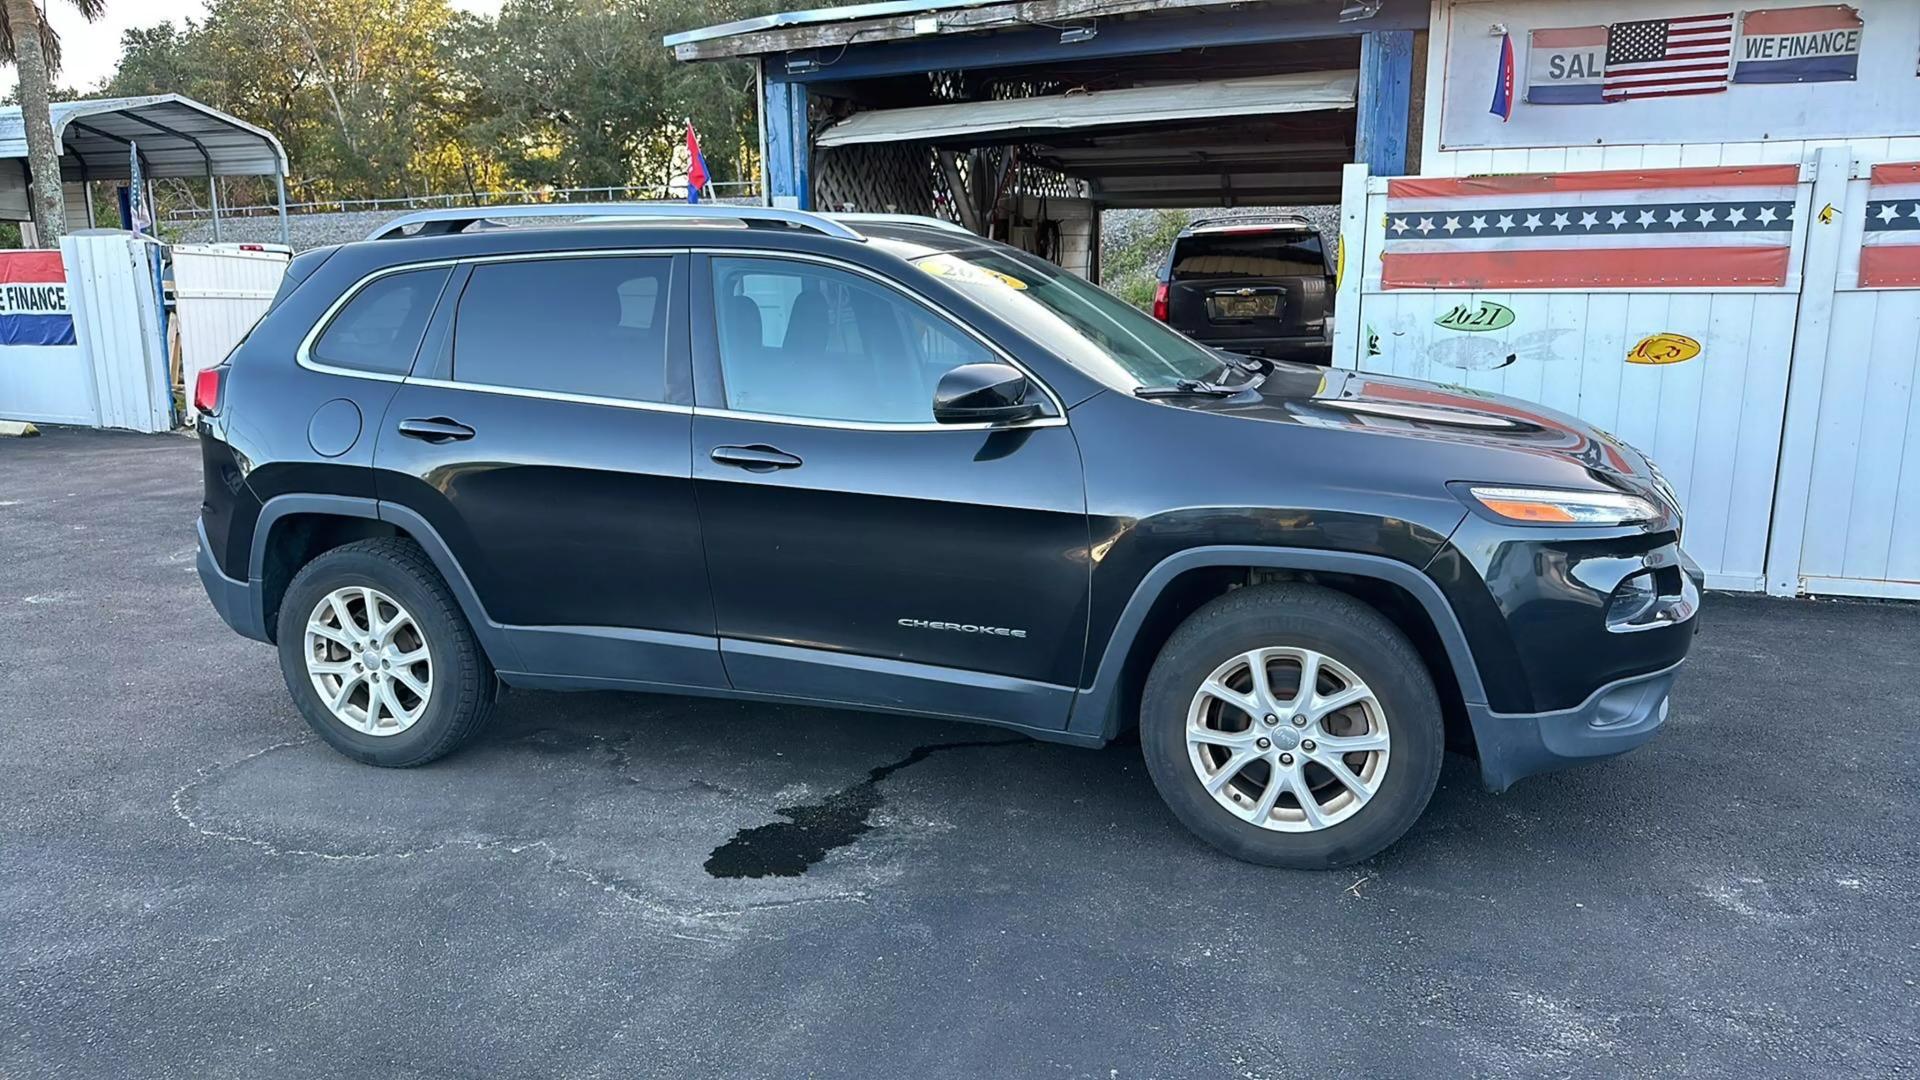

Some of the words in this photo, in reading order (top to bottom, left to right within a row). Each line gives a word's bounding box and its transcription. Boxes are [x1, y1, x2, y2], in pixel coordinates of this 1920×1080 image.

[1746, 37, 1775, 58] WE
[1777, 31, 1858, 57] FINANCE
[1549, 53, 1601, 79] SAL
[6, 286, 66, 310] FINANCE
[897, 618, 1027, 638] CHEROKEE
